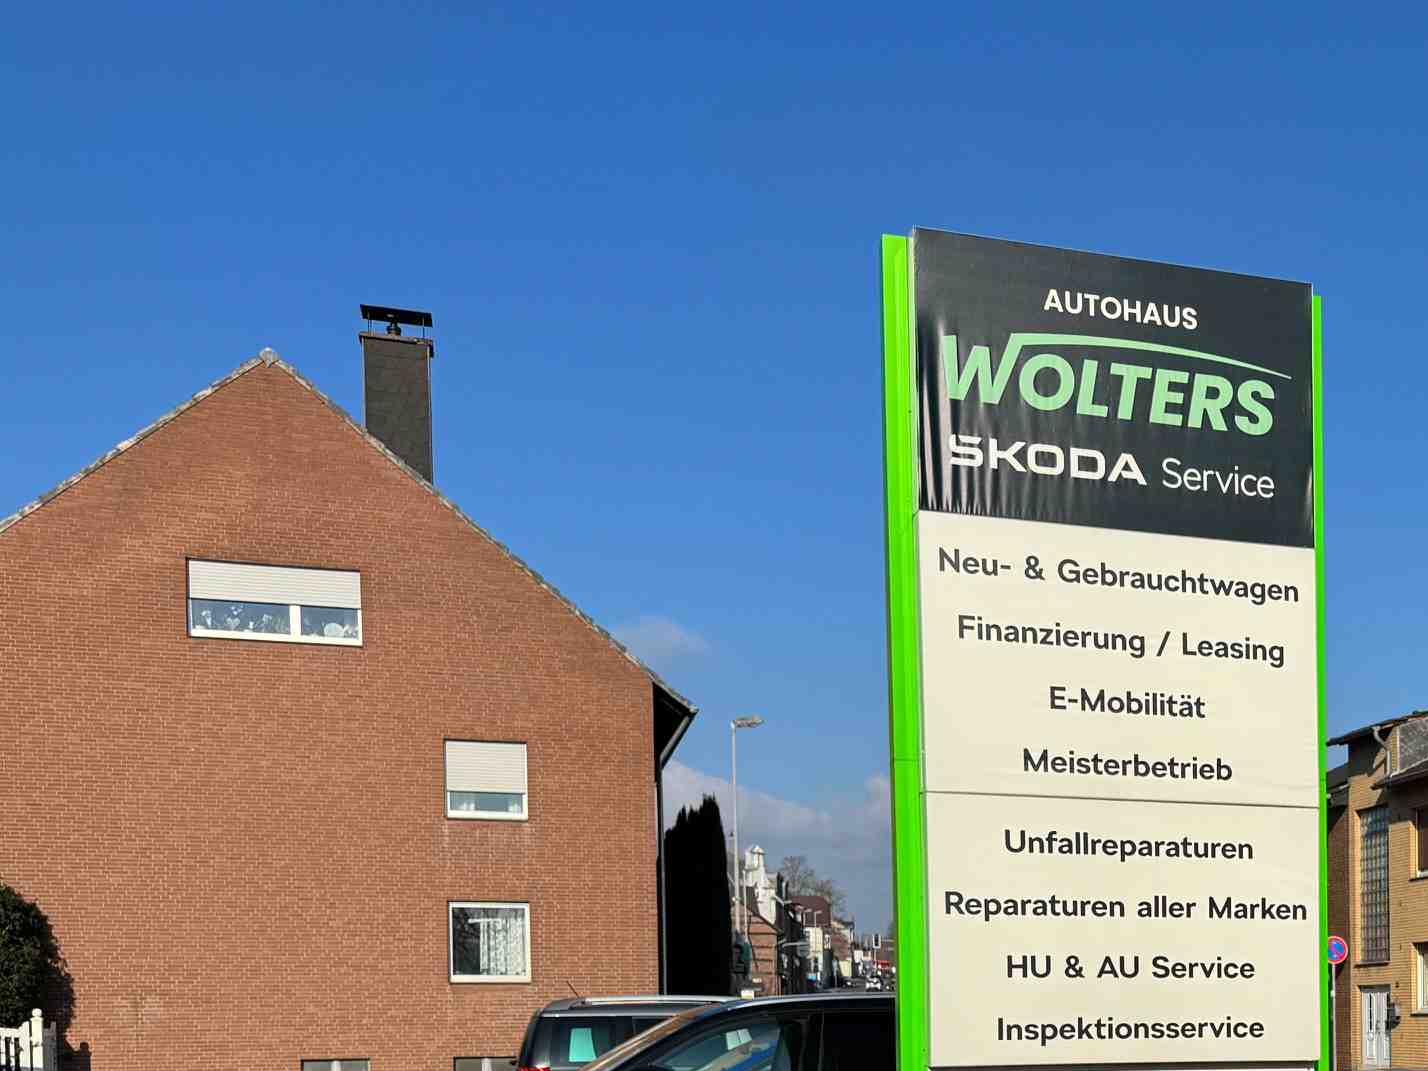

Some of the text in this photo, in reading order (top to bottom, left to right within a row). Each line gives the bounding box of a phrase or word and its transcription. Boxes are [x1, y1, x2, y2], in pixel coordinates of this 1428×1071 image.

[1043, 289, 1198, 329] AUTOHAUS
[942, 333, 1276, 436] WOLTERS
[1162, 458, 1275, 498] Service
[938, 547, 1299, 605] Neu- & Gebrauchtwagen
[957, 615, 1285, 668] Finanzierung / Leasing
[1049, 686, 1206, 718] E-Mobilität
[1023, 748, 1233, 781] Meisterbetrieb
[1004, 829, 1254, 862] Unfallreparaturen
[944, 890, 1307, 922] Reparaturen aller Marken
[1007, 955, 1255, 979] HU & AU Service
[998, 1016, 1265, 1046] Inspektionsservice
